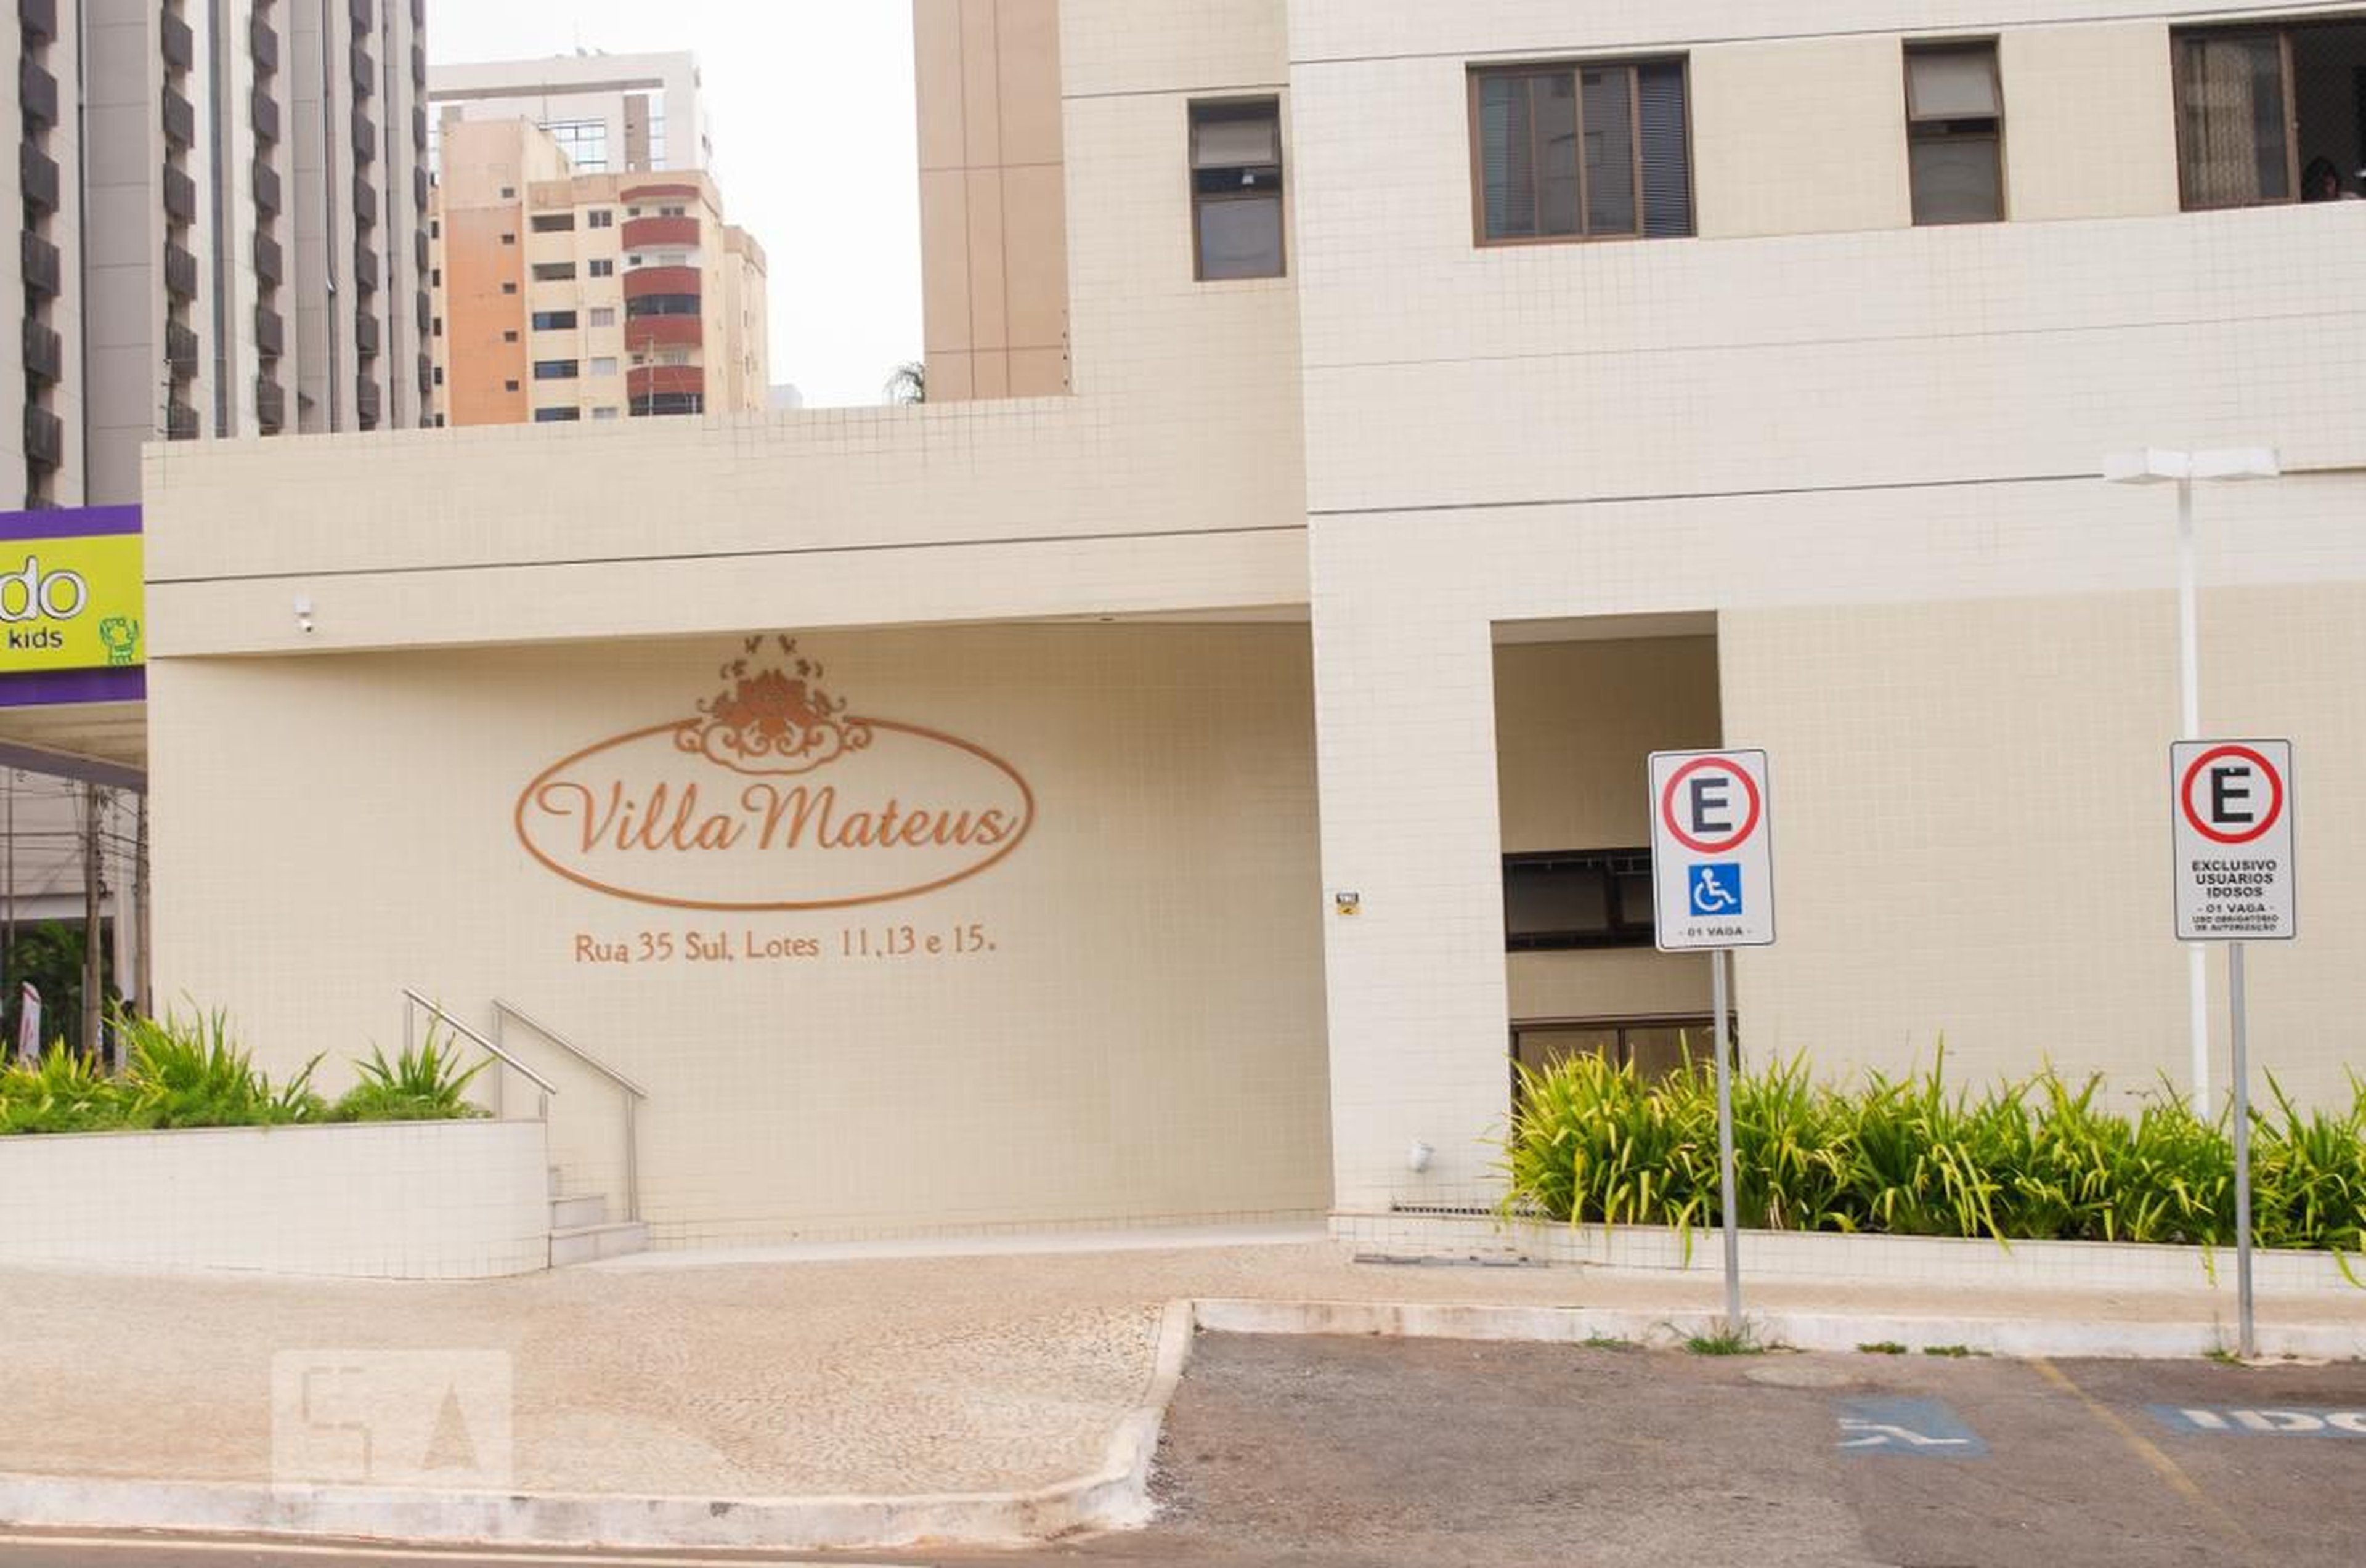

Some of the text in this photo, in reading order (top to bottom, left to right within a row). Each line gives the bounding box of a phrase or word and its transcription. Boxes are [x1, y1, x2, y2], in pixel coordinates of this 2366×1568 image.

[9, 627, 63, 649] kids
[1691, 778, 1732, 833] E
[2211, 767, 2253, 823] E
[537, 780, 1020, 853] Villa Mateus
[2191, 859, 2277, 872] EXCLUSIVO
[2206, 886, 2264, 898] IDOSOS
[575, 934, 628, 963] Rua
[637, 931, 673, 962] 35
[746, 930, 818, 959] Lotes
[926, 933, 942, 954] e
[954, 924, 997, 953] 15.
